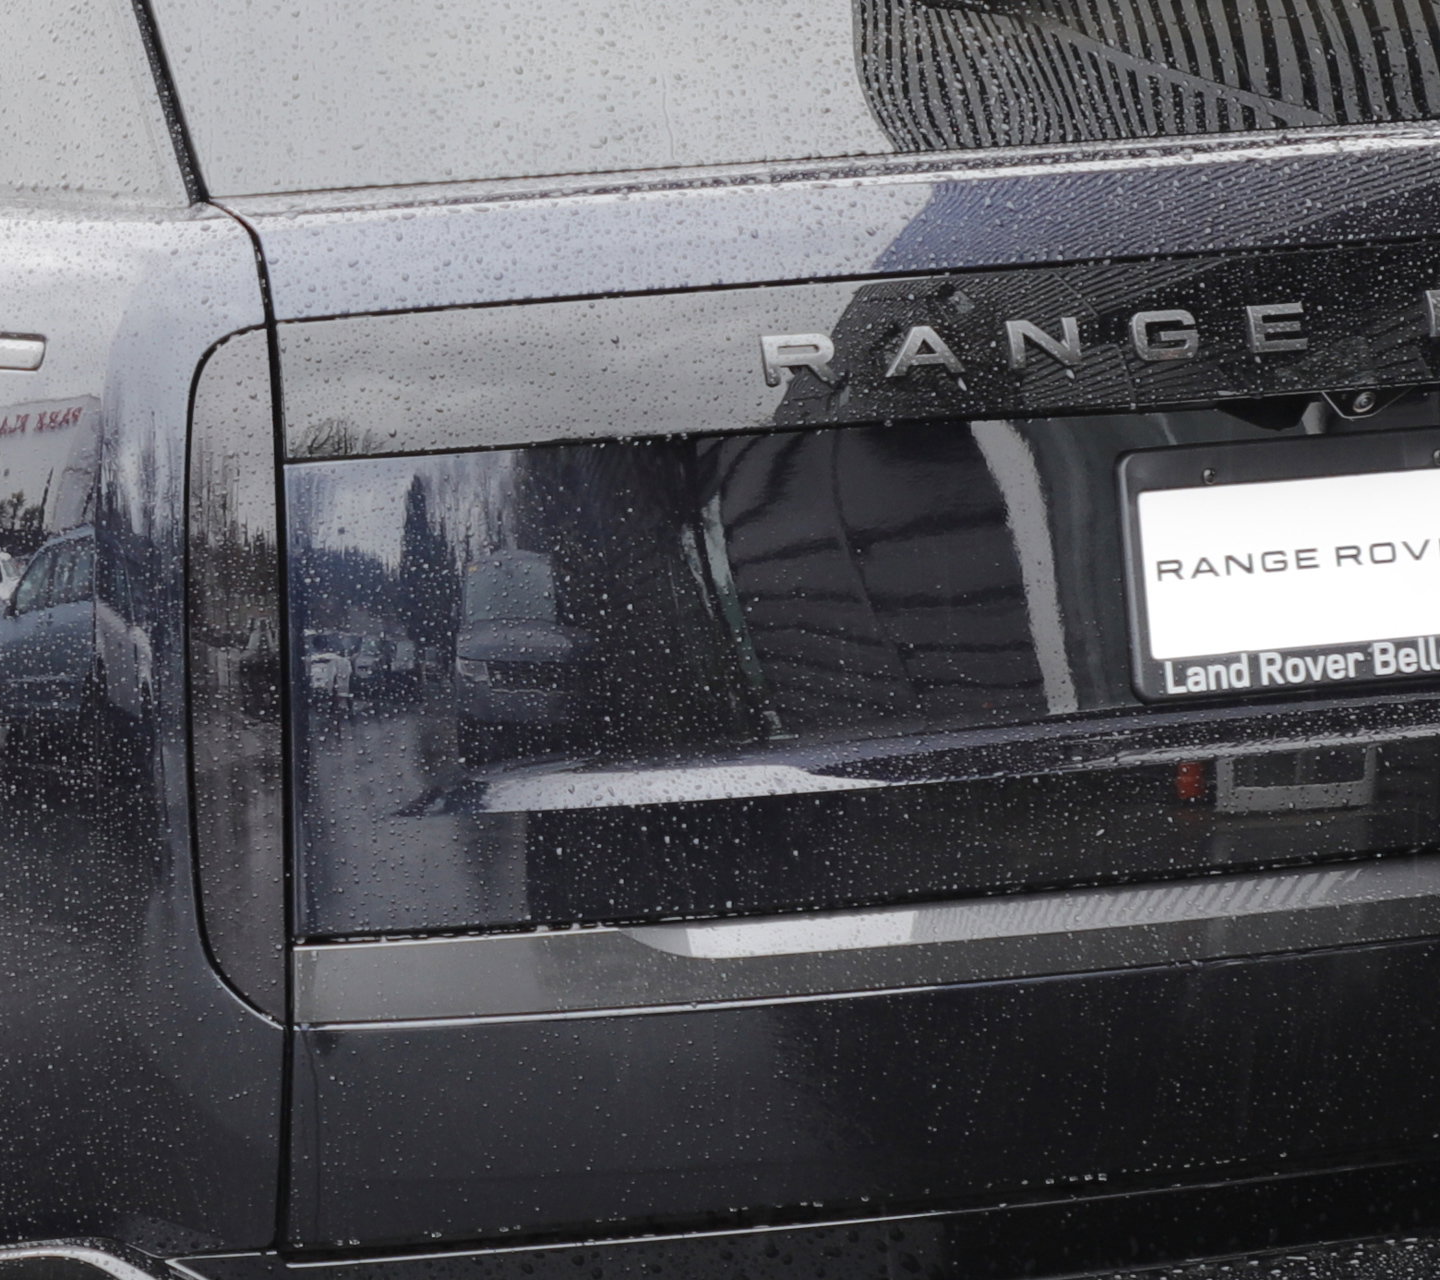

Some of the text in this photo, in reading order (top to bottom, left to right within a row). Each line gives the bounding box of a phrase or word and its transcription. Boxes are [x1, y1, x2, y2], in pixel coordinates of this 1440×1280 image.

[759, 301, 1309, 388] RANGE
[1156, 548, 1320, 581] RANGE
[1164, 653, 1250, 695] Land
[1259, 649, 1364, 686] Rover
